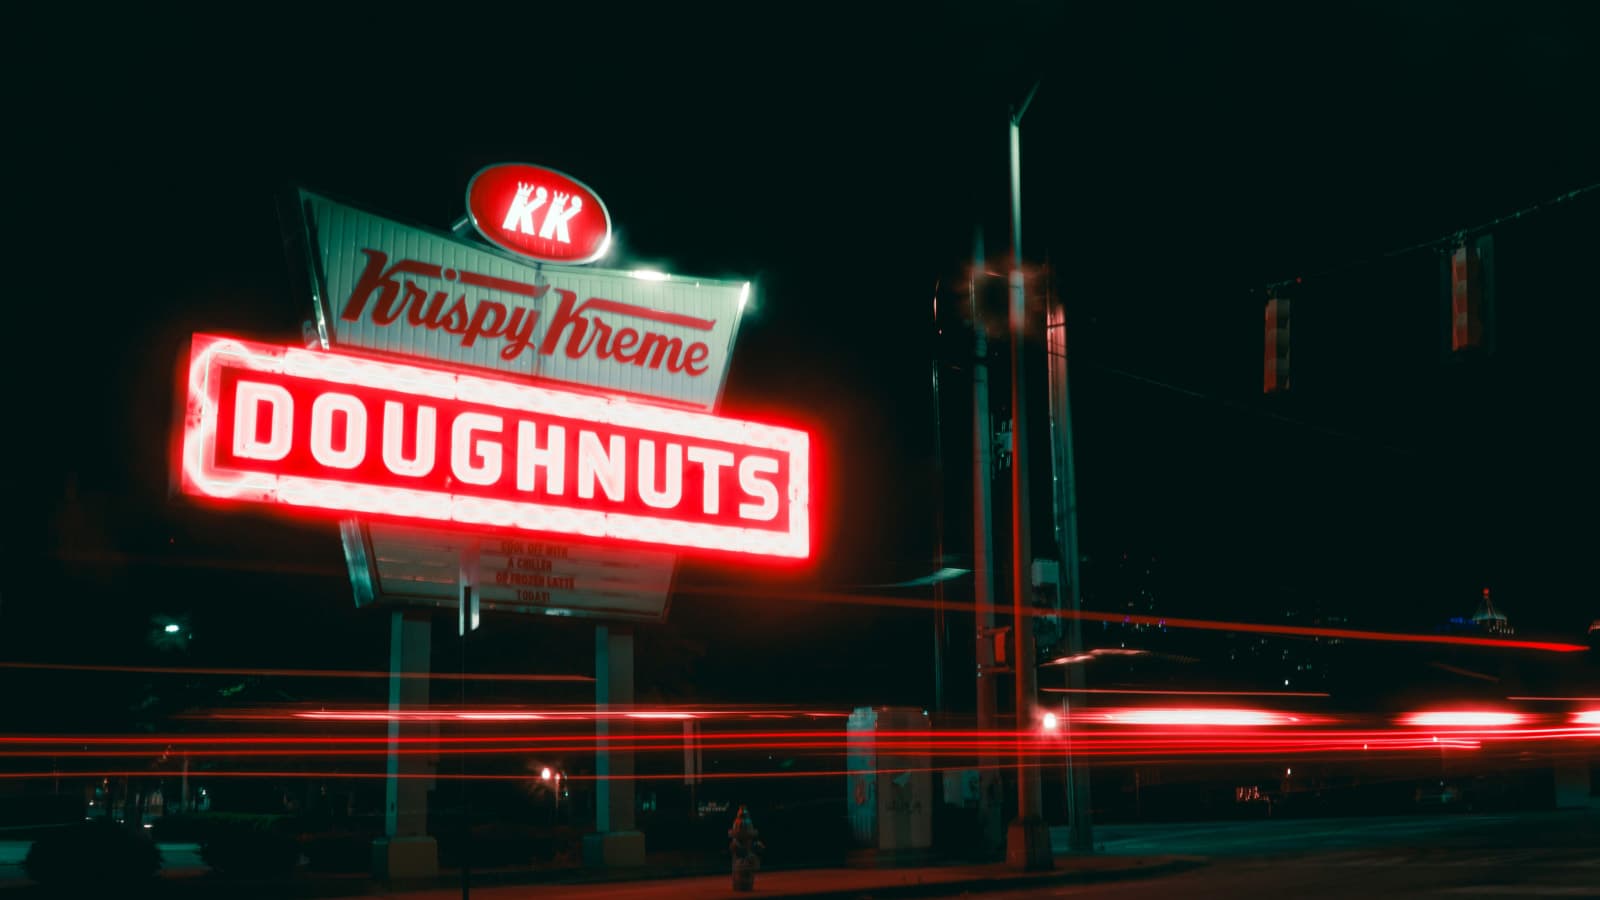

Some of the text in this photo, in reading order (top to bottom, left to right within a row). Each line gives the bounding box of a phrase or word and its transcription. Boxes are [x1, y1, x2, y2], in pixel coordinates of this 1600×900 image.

[502, 180, 583, 244] KK
[340, 248, 716, 377] Krispy Kreme
[231, 380, 780, 523] DOUGHNUTS
[545, 544, 569, 559] WITH
[507, 557, 552, 572] A CHILLER
[509, 573, 545, 588] FROZEN
[547, 575, 575, 590] LATTE
[517, 590, 552, 602] TODAY!
